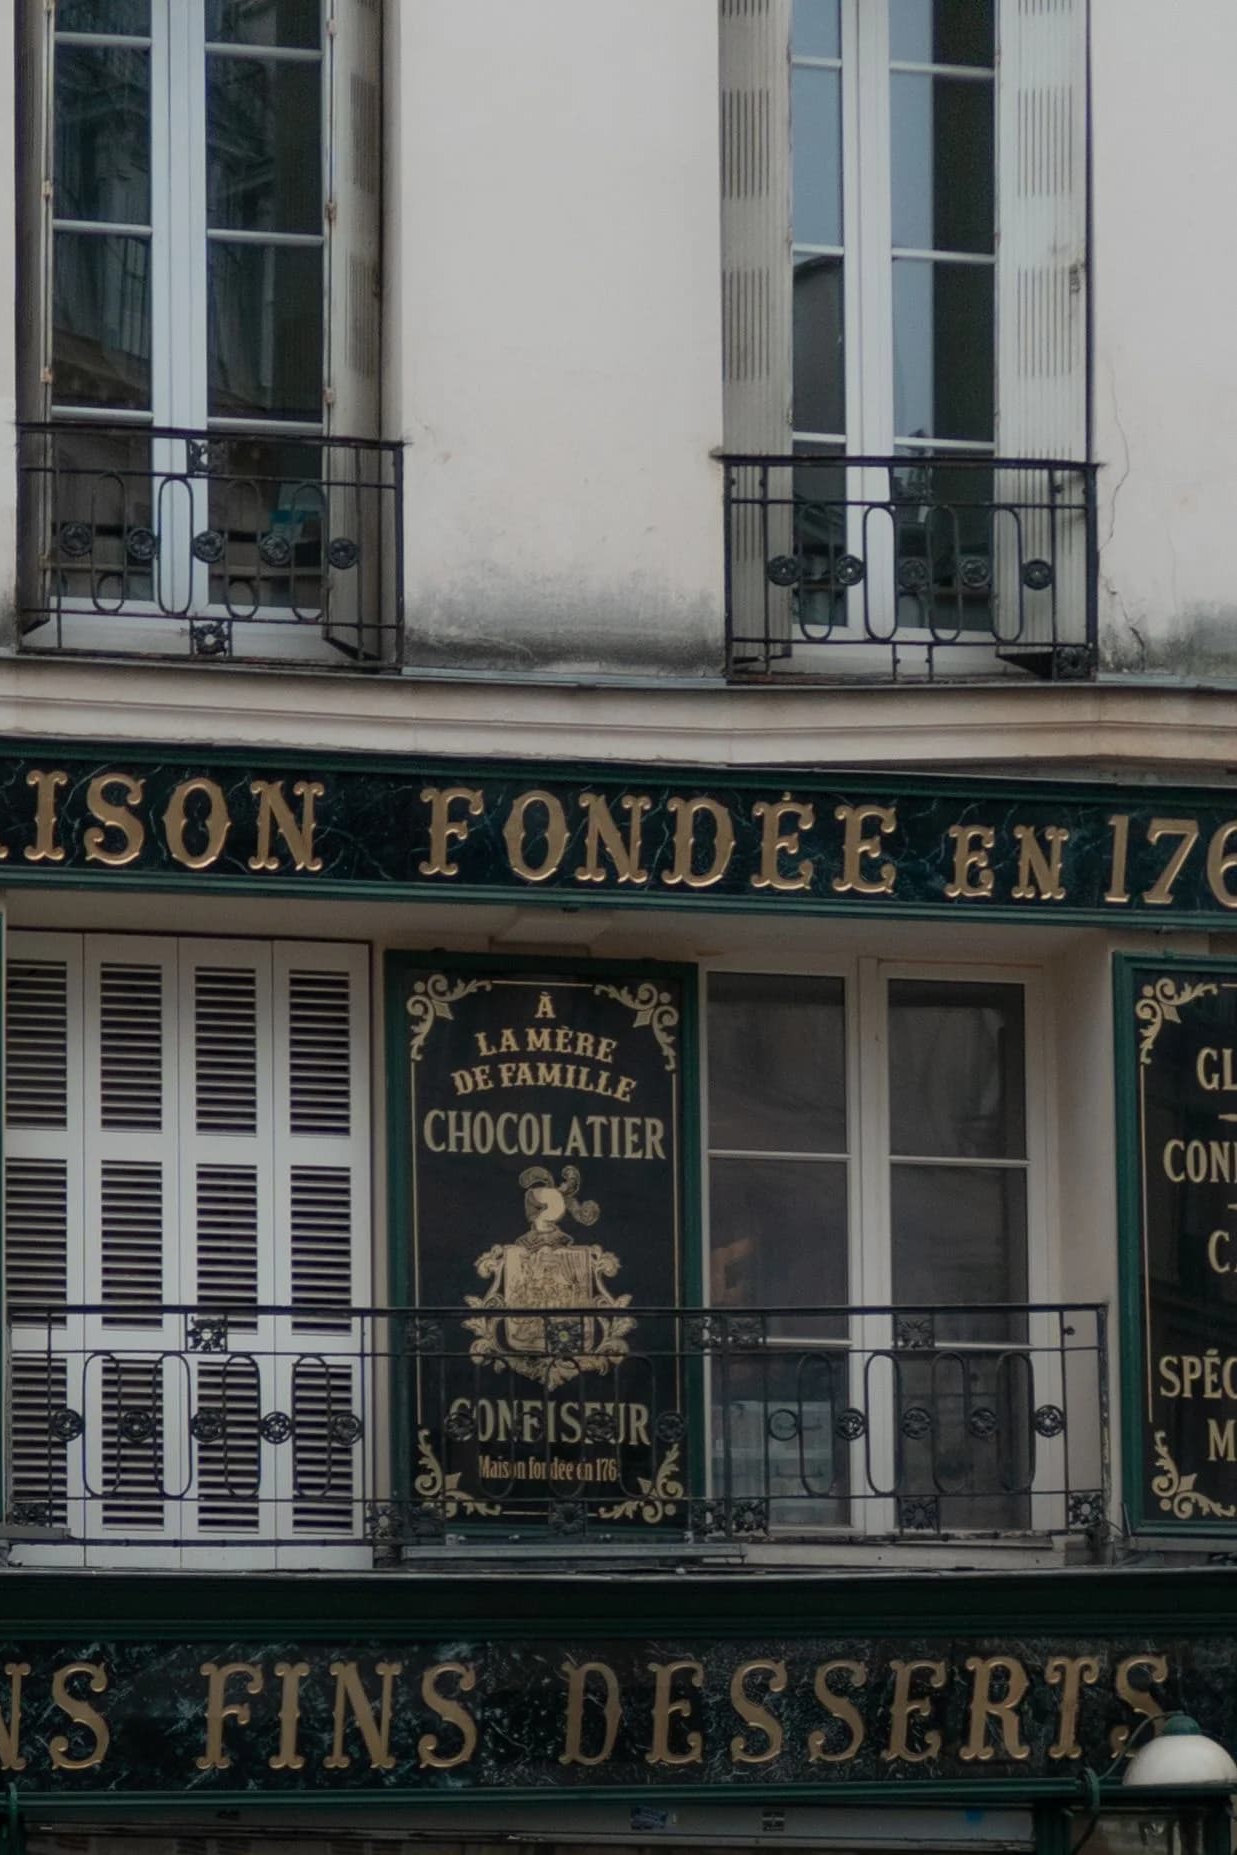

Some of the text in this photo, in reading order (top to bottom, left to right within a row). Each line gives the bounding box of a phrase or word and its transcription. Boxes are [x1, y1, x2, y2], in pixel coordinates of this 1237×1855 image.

[417, 787, 898, 896] FONDÉE
[944, 822, 1070, 901] EN
[477, 1023, 618, 1064] LA MÈRE
[451, 1062, 636, 1103] DE FAMILLE
[423, 1108, 666, 1160] CHOCOLATIER
[196, 1661, 478, 1770] FINS
[562, 1655, 1170, 1766] DESSERTS
